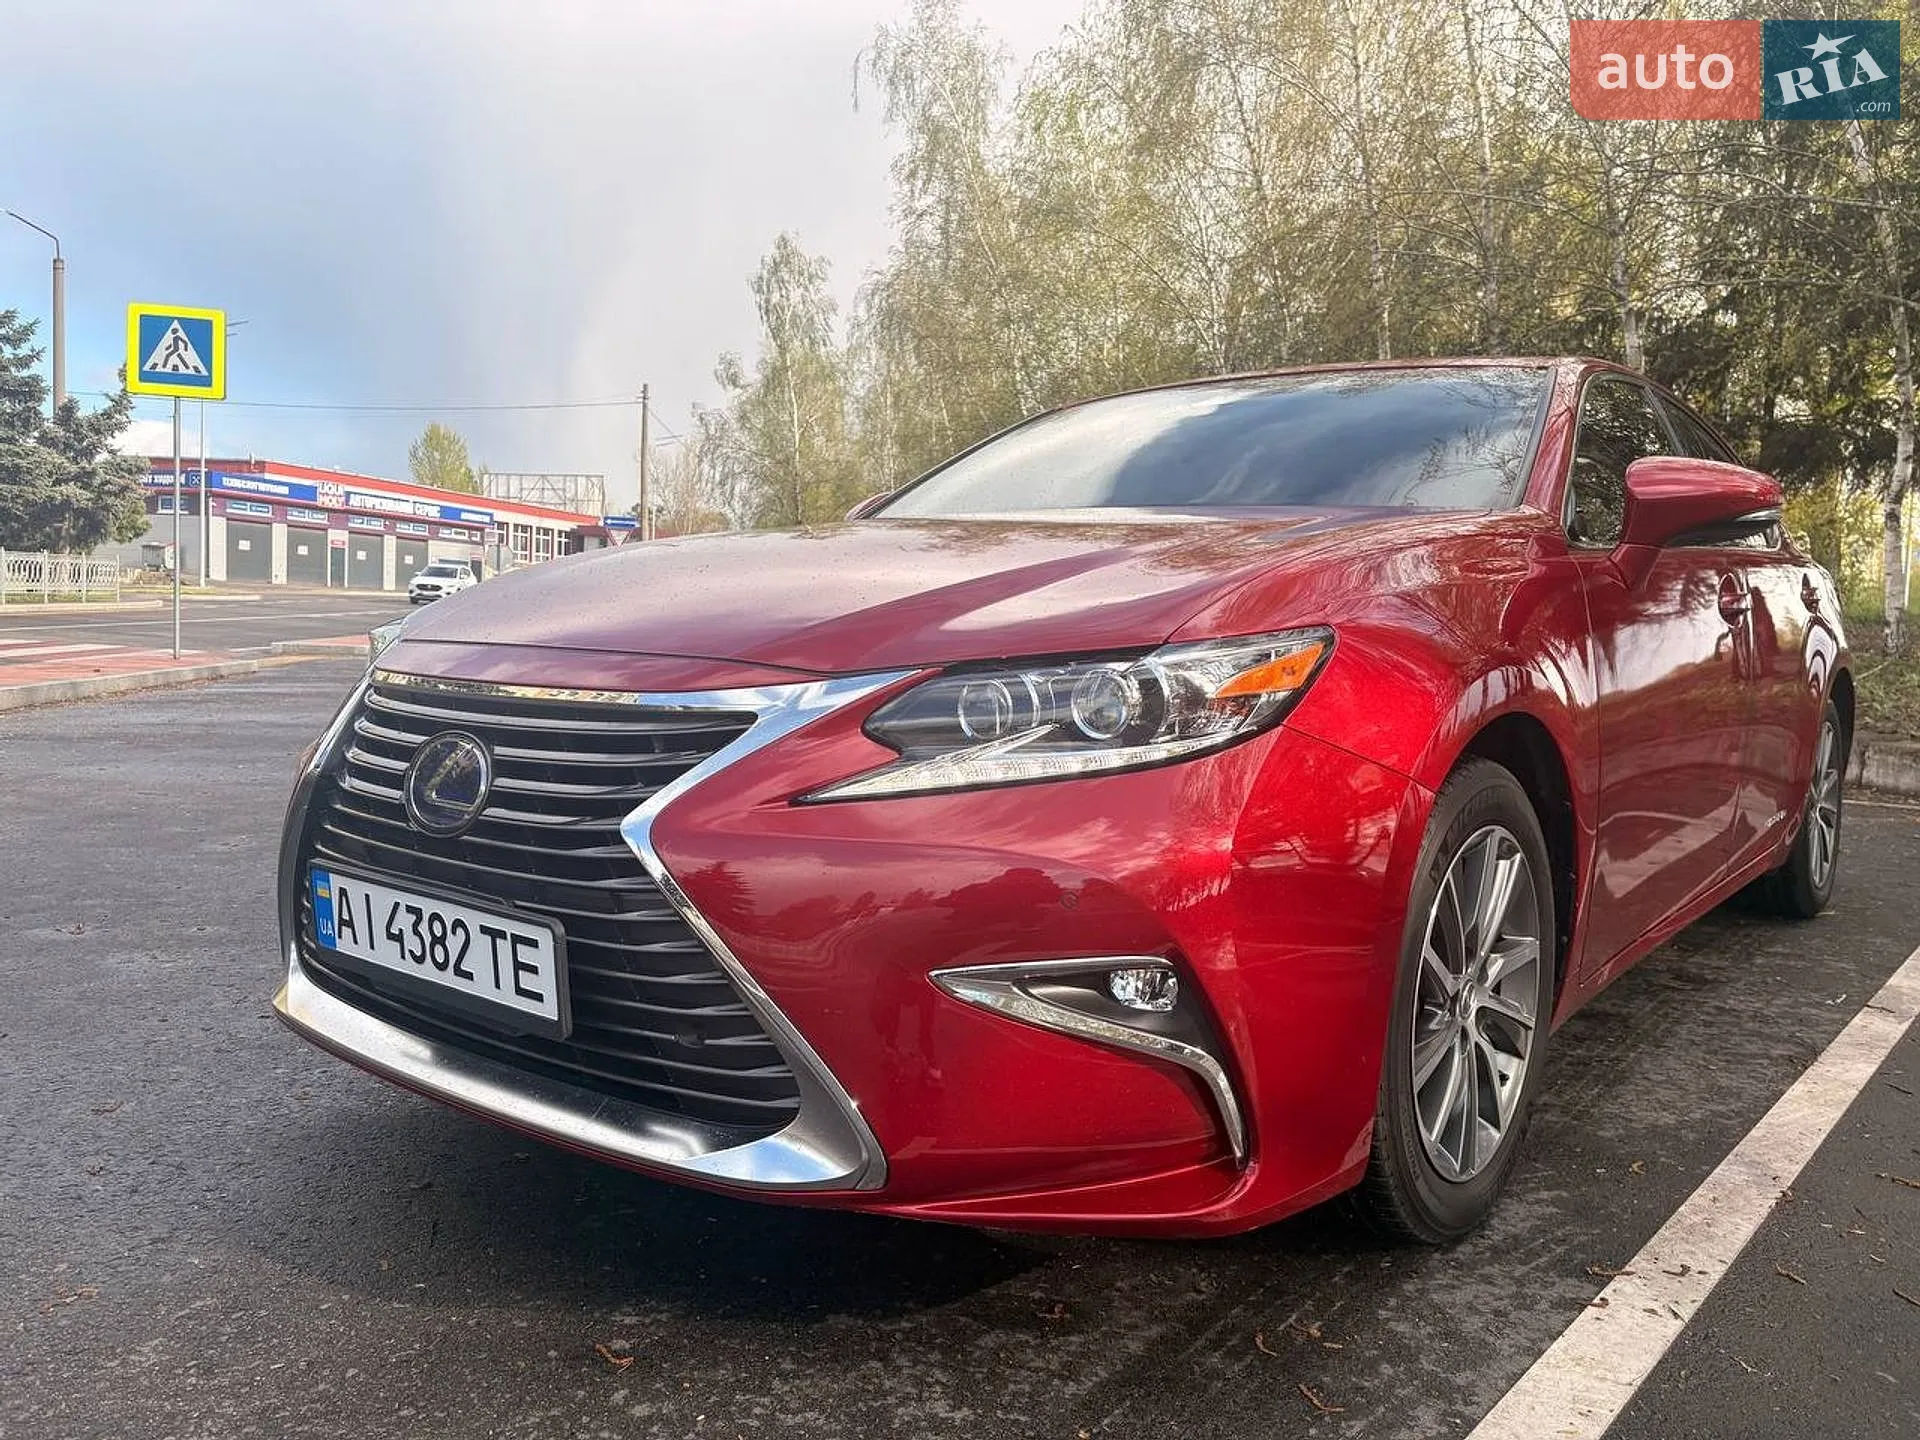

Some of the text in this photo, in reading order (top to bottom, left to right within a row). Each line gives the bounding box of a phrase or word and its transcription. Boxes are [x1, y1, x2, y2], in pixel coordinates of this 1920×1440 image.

[321, 919, 334, 937] UA
[337, 886, 545, 1003] AI 4382 TE
